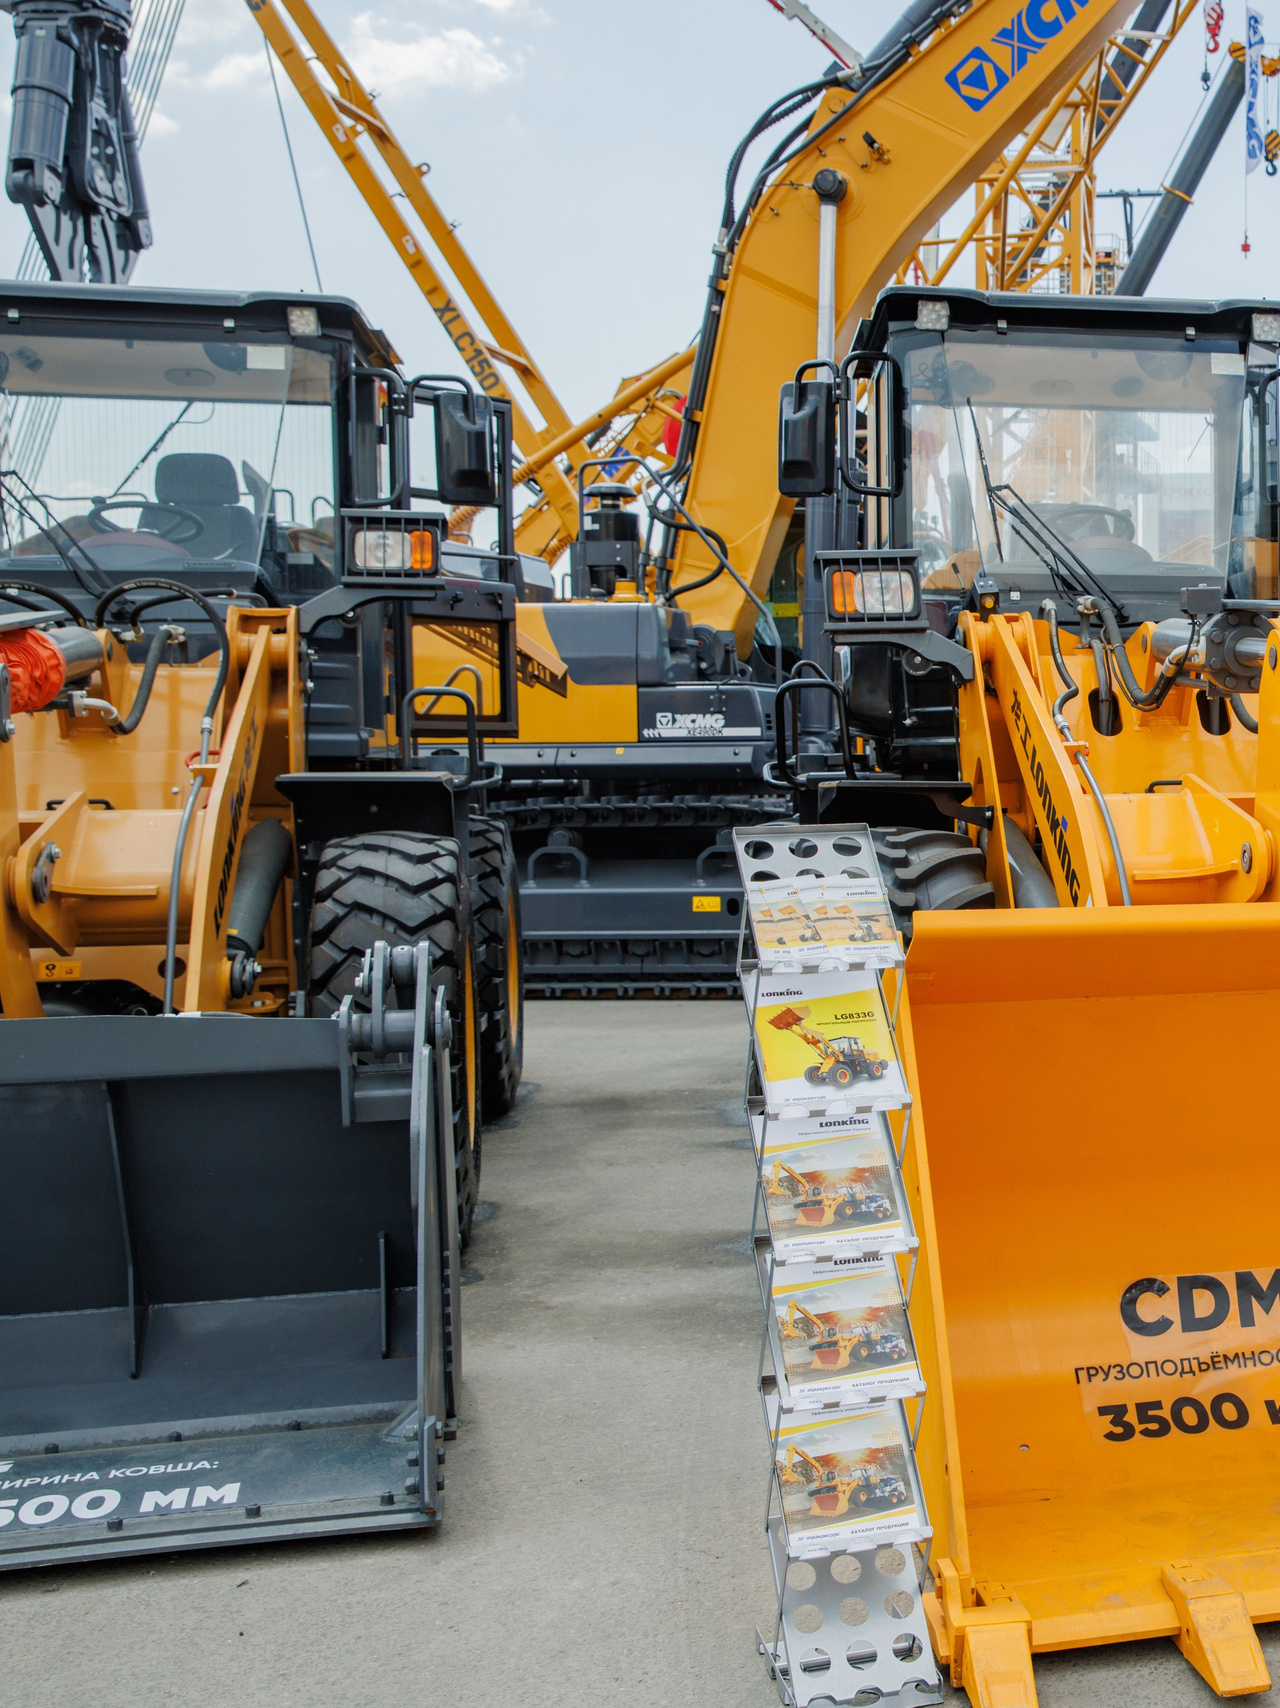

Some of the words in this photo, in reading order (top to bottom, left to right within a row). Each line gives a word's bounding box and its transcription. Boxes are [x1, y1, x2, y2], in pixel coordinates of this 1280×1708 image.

[433, 297, 500, 391] XLC150
[674, 713, 725, 728] XCMG
[834, 1011, 875, 1020] LG833G
[1097, 1392, 1250, 1442] 3500
[108, 1460, 219, 1479] КОВША:
